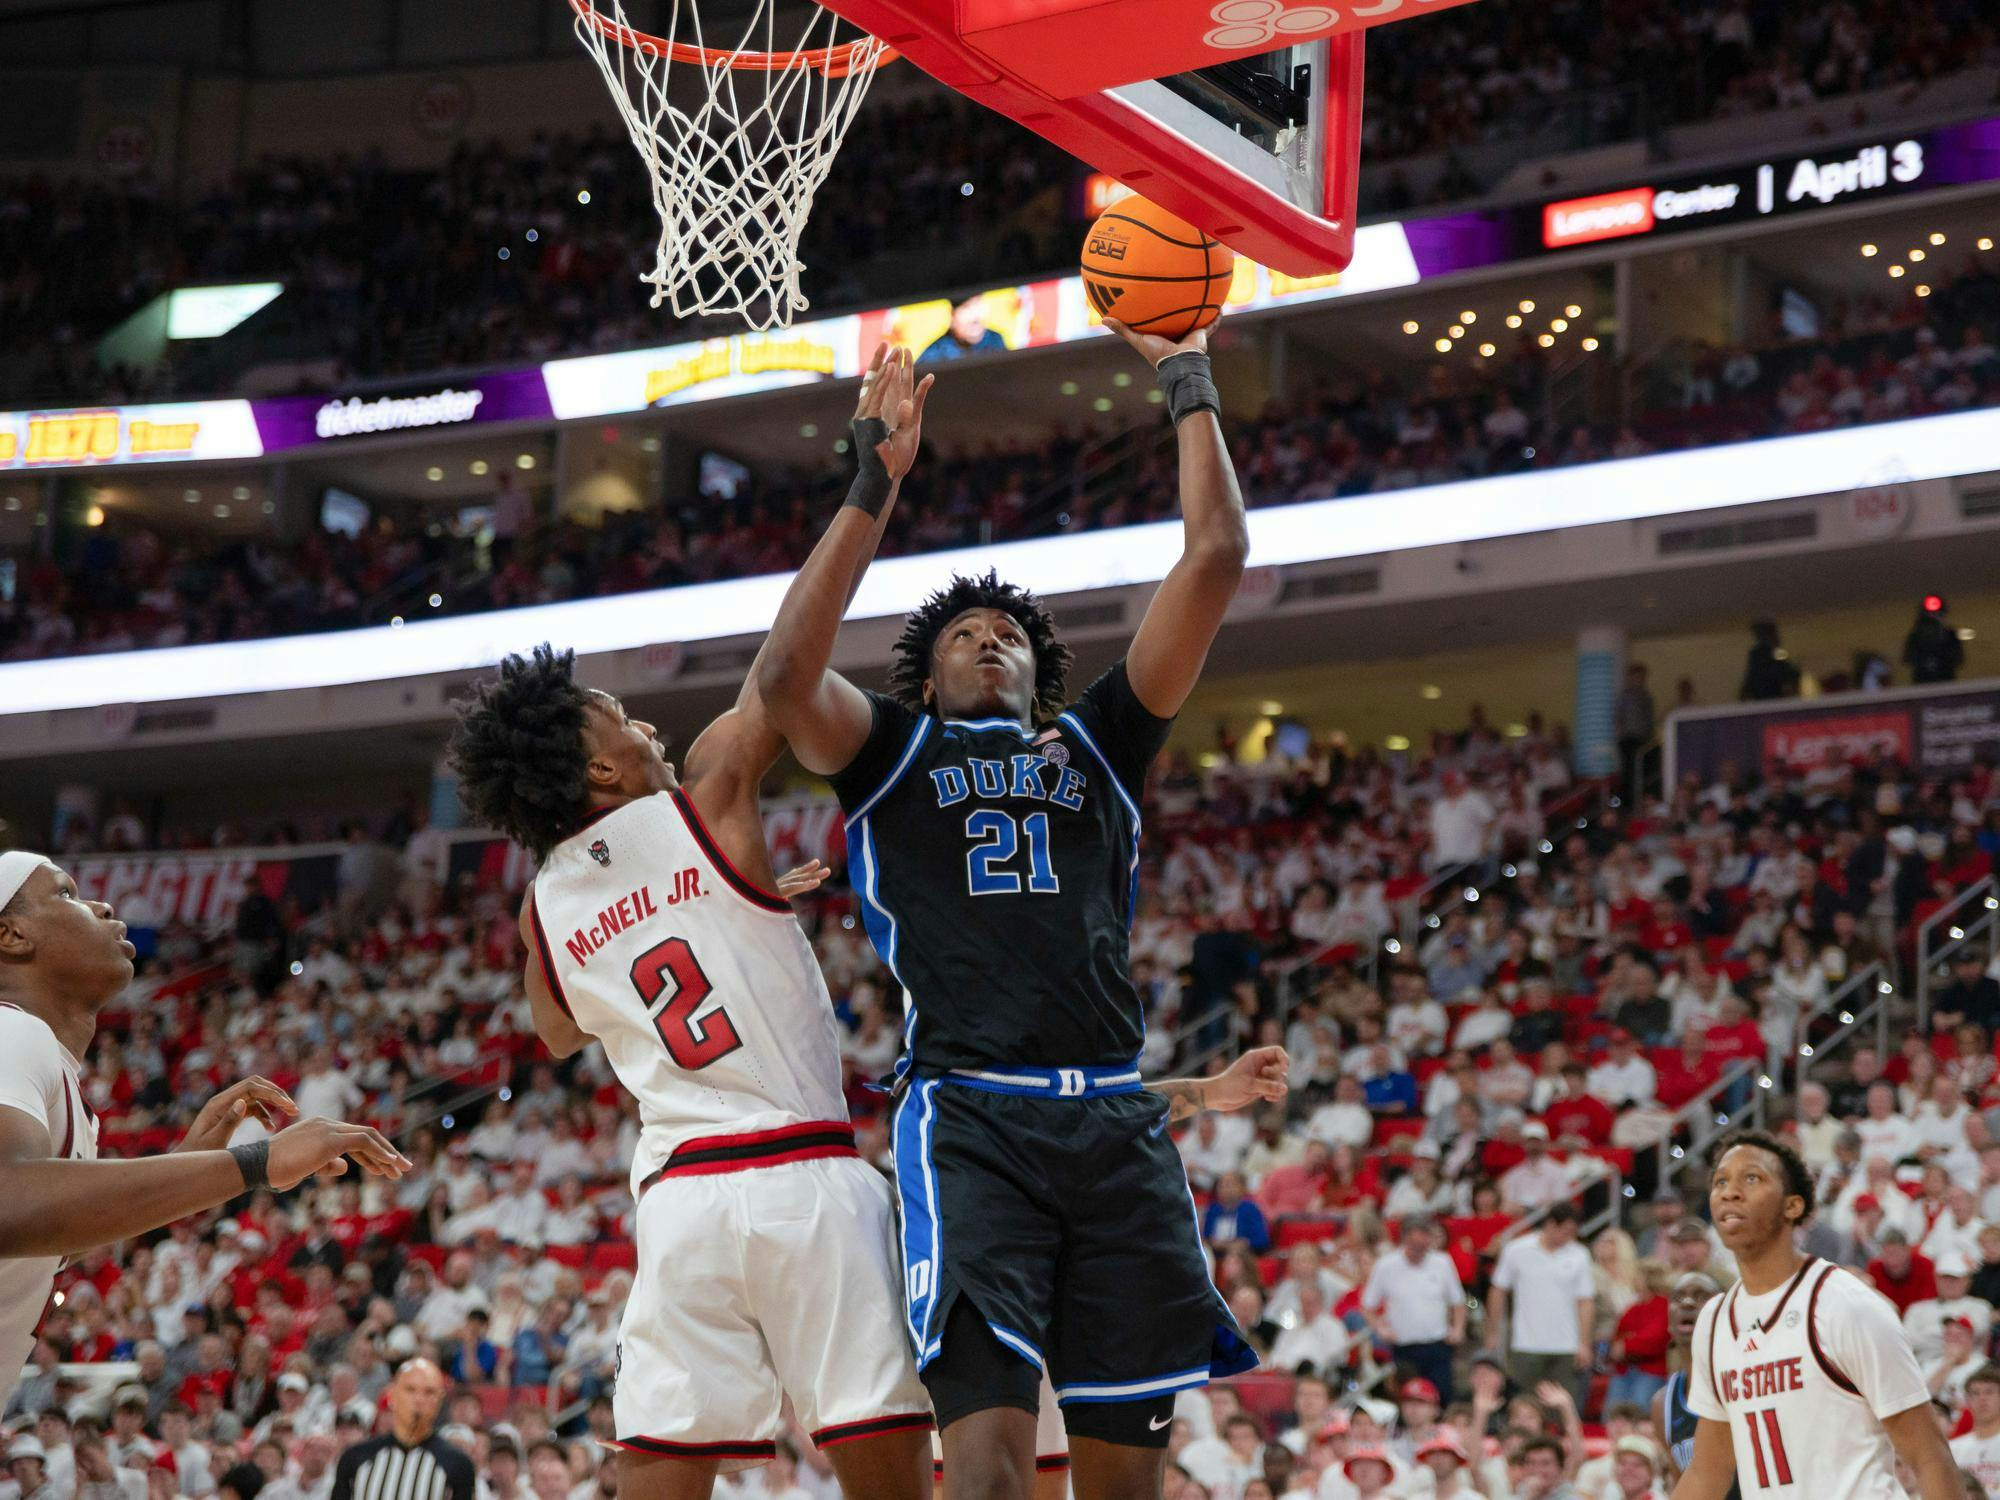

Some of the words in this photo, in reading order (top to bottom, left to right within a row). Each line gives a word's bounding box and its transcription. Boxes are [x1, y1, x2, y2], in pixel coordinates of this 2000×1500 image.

[1552, 201, 1645, 237] Lenovo
[1653, 183, 1740, 220] Center
[1786, 145, 1887, 203] April
[1891, 139, 1924, 183] 3
[1088, 238, 1127, 261] PRO
[316, 388, 483, 438] ticketmaster
[929, 754, 1087, 811] DUKE
[965, 808, 1060, 897] 21
[565, 886, 658, 968] McNEIL
[667, 867, 710, 906] JR.
[629, 936, 744, 1072] 2
[1742, 1356, 1804, 1400] STATE
[1744, 1407, 1794, 1489] 11
